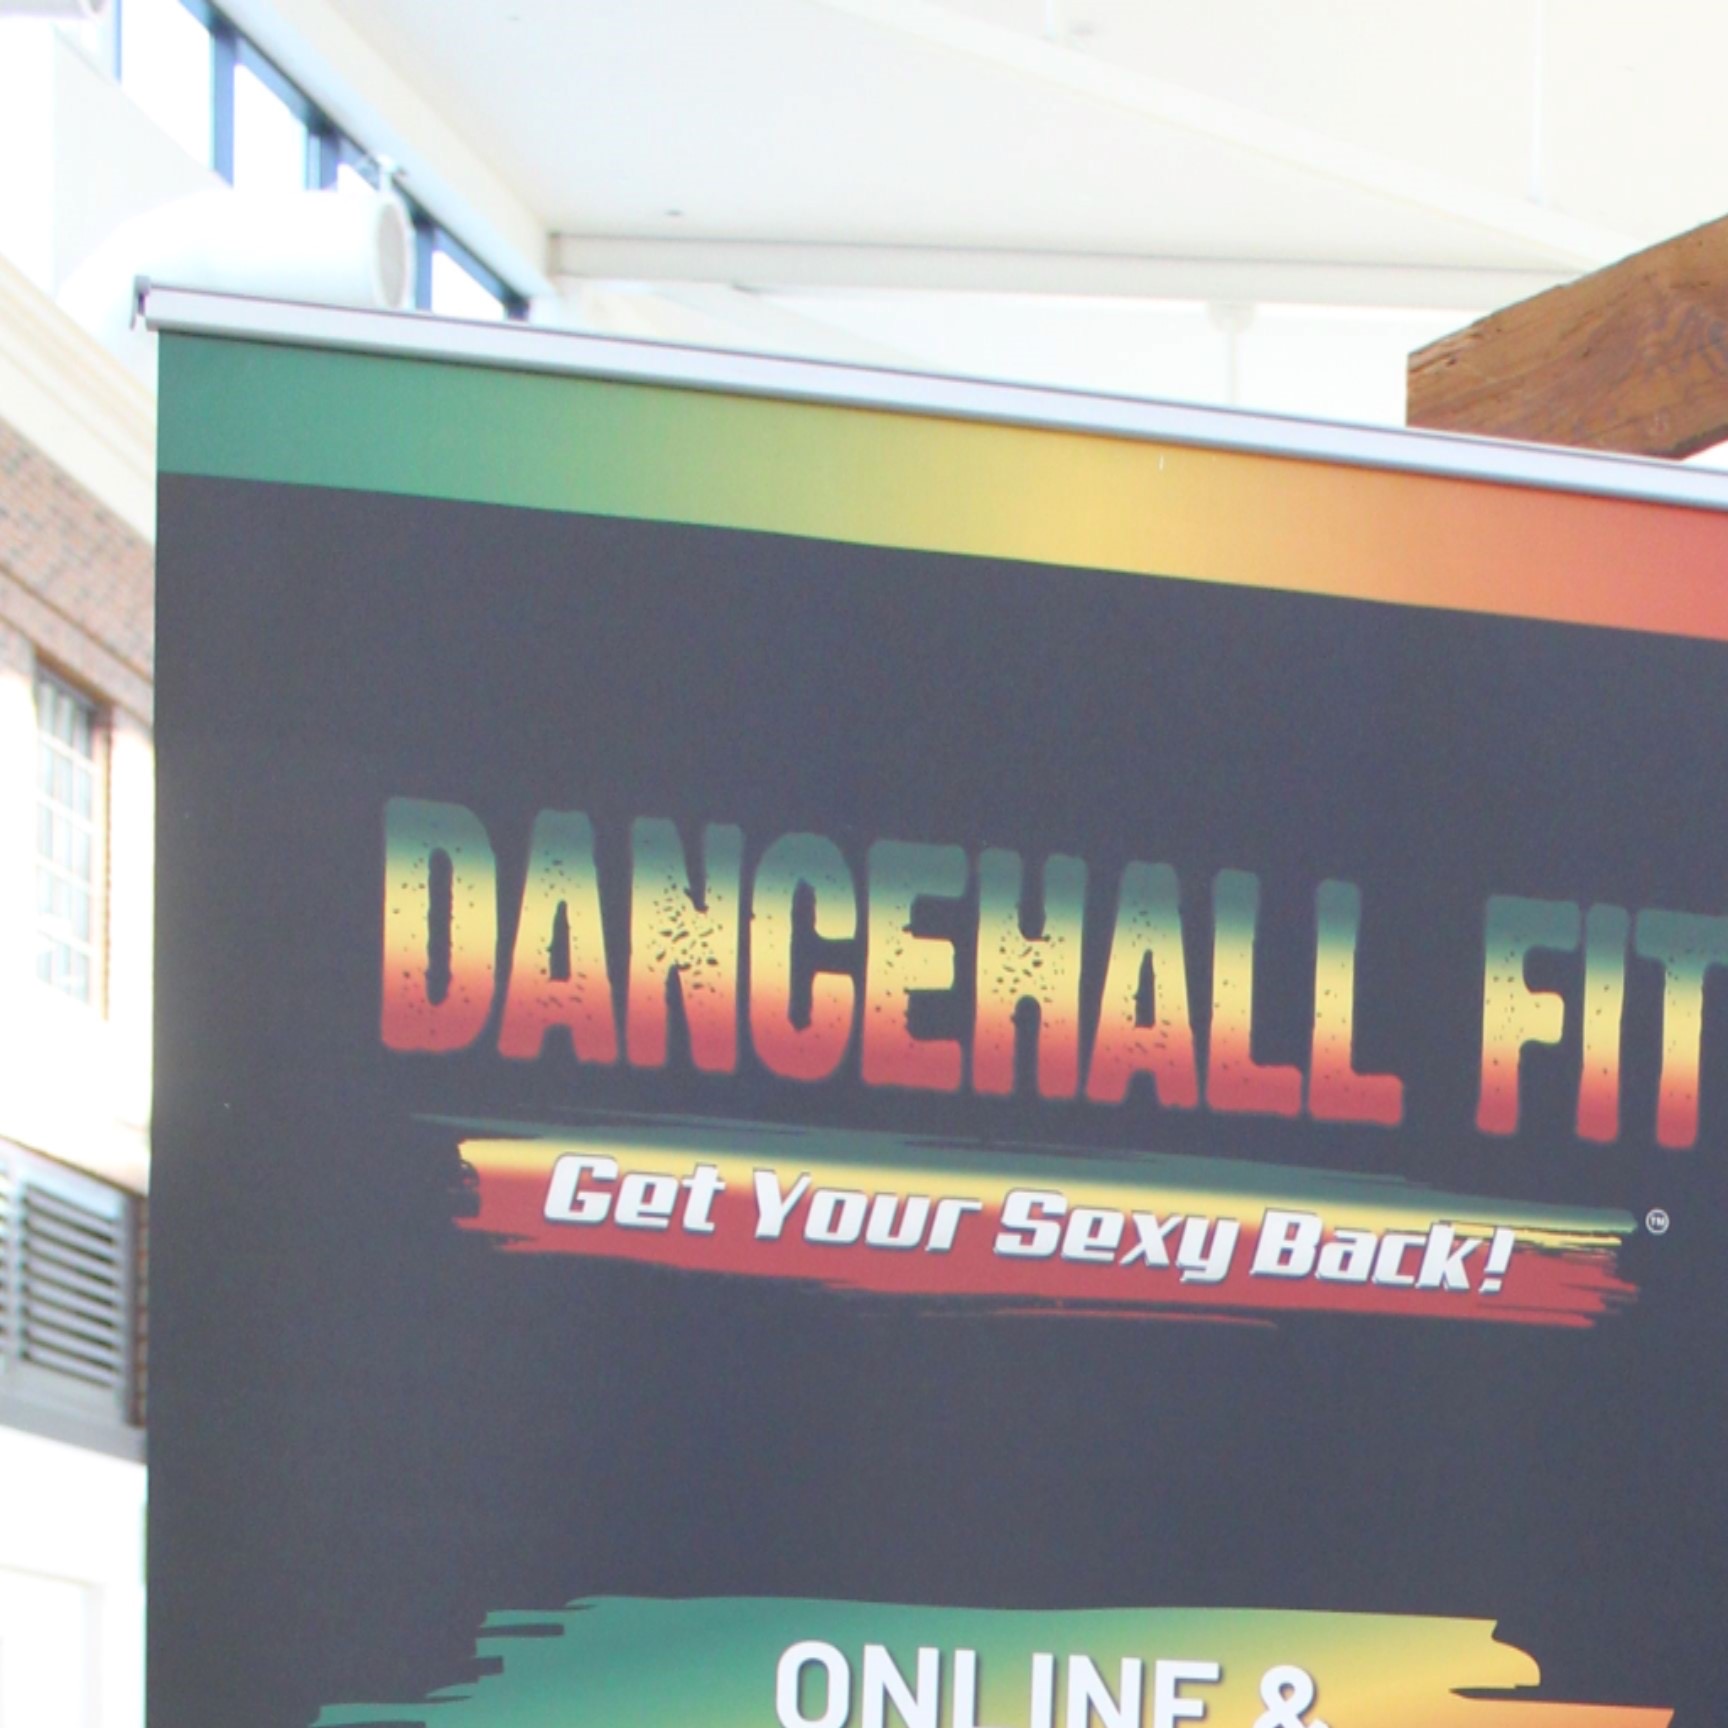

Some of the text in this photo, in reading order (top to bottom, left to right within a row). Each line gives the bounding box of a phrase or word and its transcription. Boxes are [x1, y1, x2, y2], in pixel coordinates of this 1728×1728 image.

[380, 796, 1404, 1126] DANCEHALL
[543, 1151, 726, 1235] Get
[751, 1168, 983, 1252] Your
[993, 1187, 1240, 1284] Sexy
[1250, 1206, 1515, 1295] Back!
